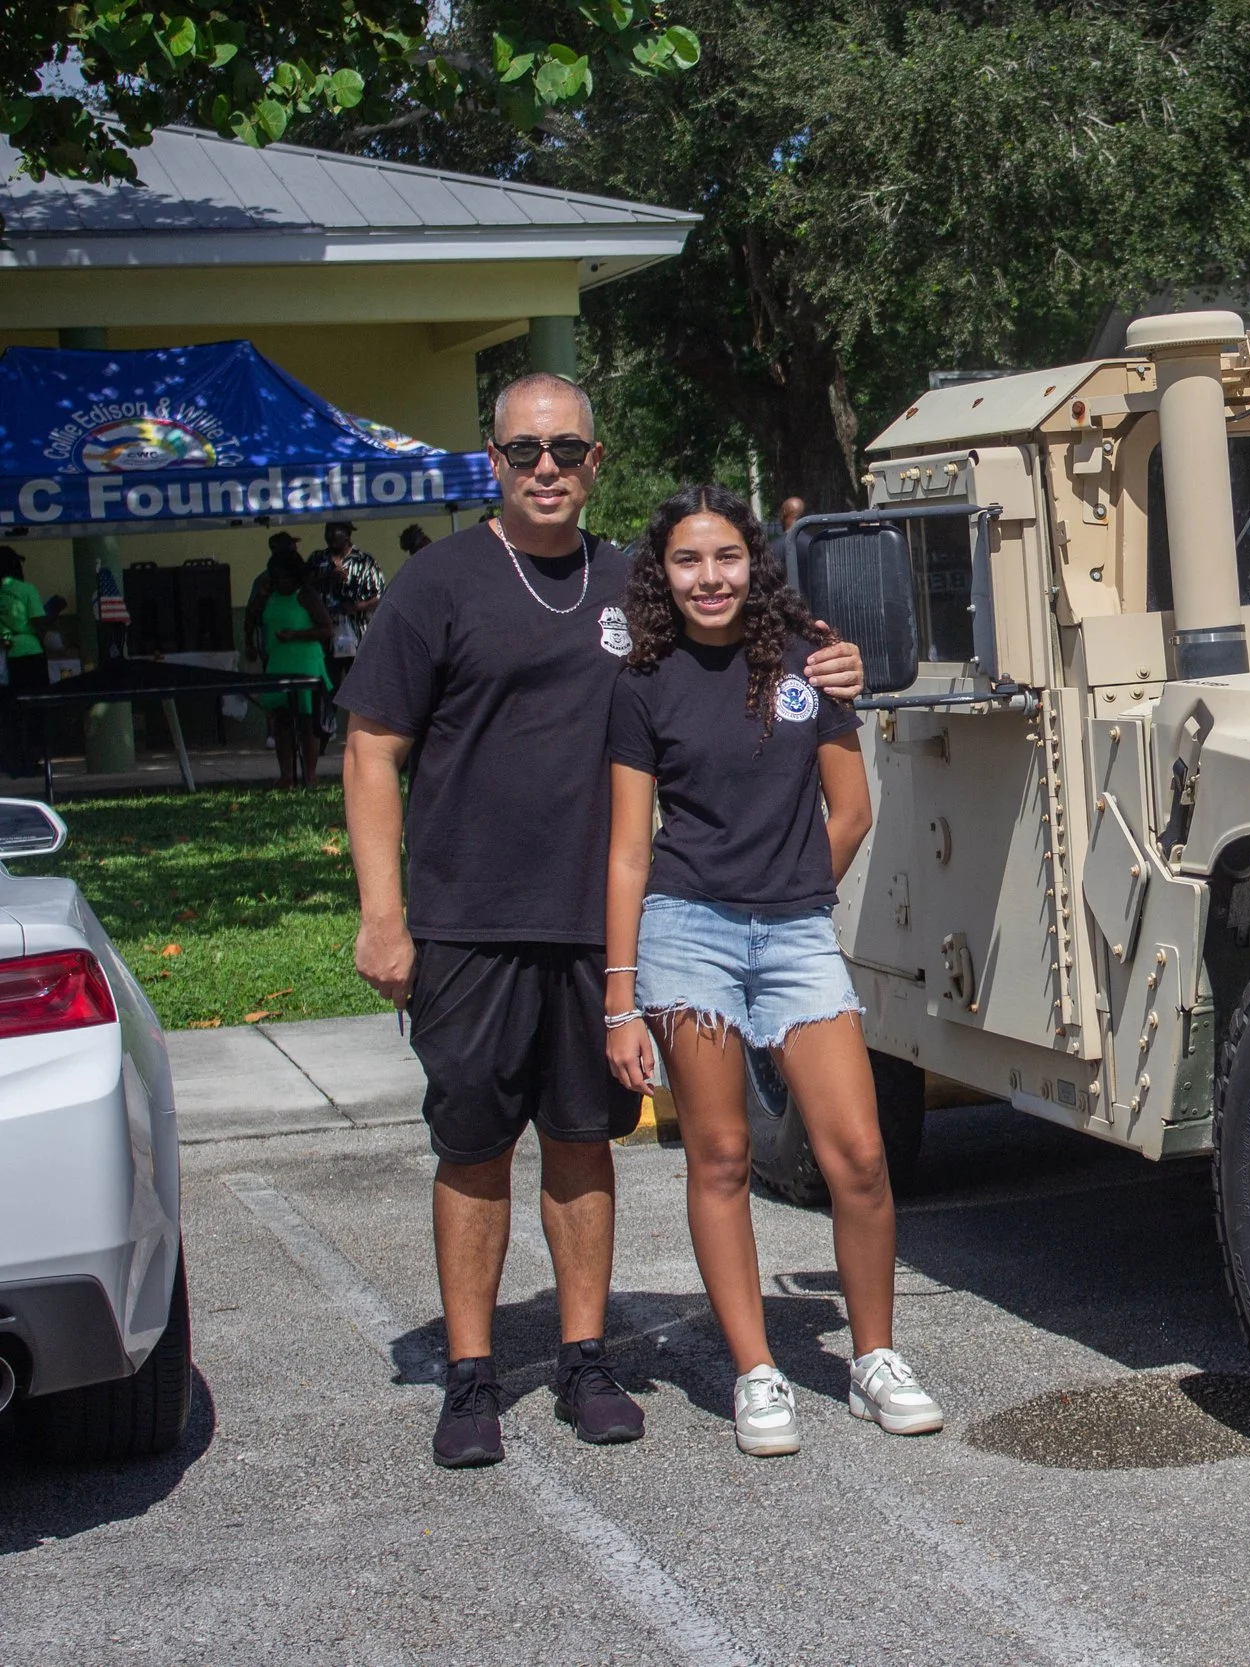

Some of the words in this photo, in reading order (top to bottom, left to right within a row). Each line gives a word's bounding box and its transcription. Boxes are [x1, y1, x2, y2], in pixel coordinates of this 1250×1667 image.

[72, 401, 148, 429] Edison
[155, 397, 171, 418] &
[174, 402, 225, 440] Willie
[88, 463, 445, 519] Foundation
[805, 683, 820, 720] PROTECTION
